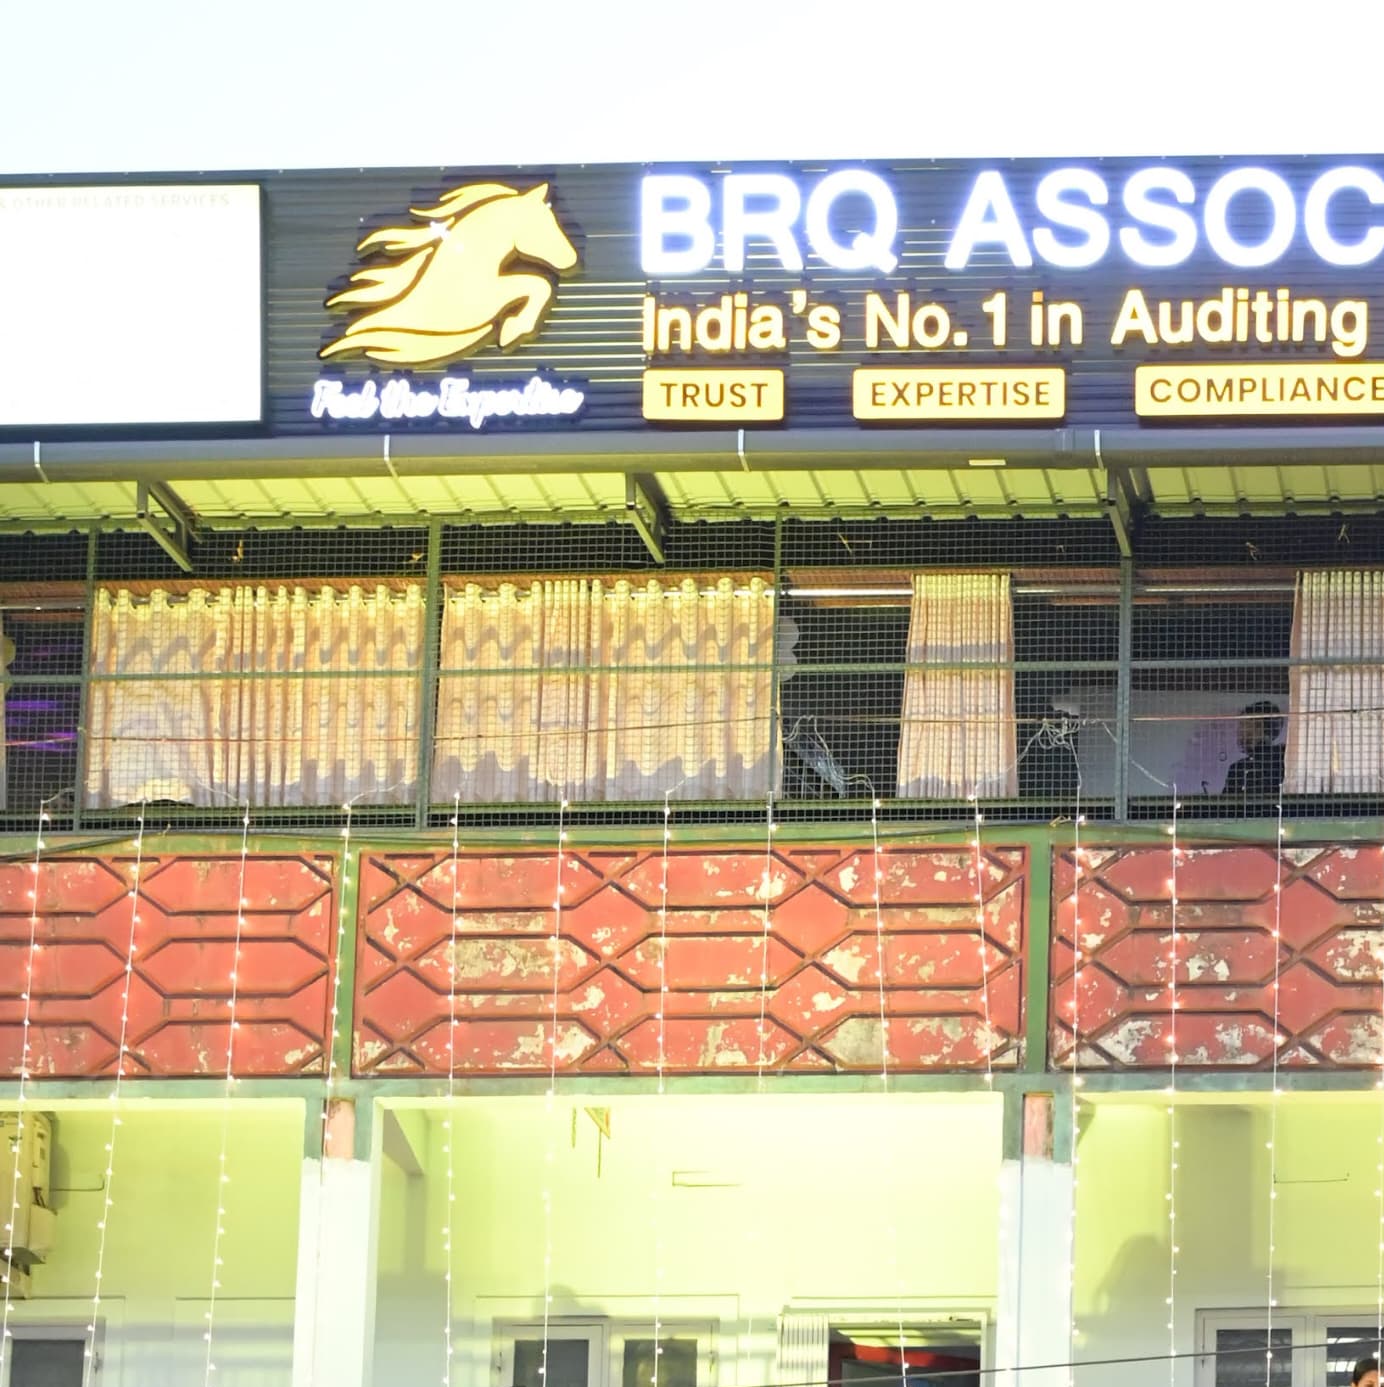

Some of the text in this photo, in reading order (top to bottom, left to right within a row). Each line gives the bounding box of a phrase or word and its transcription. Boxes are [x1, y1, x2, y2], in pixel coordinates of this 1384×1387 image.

[641, 168, 899, 274] BRQ
[643, 289, 841, 354] India's
[865, 290, 968, 348] No.
[982, 290, 1007, 347] 1
[1031, 290, 1083, 347] in
[1111, 287, 1369, 358] Auditing
[661, 381, 768, 408] TRUST
[871, 380, 1051, 407] EXPERTISE
